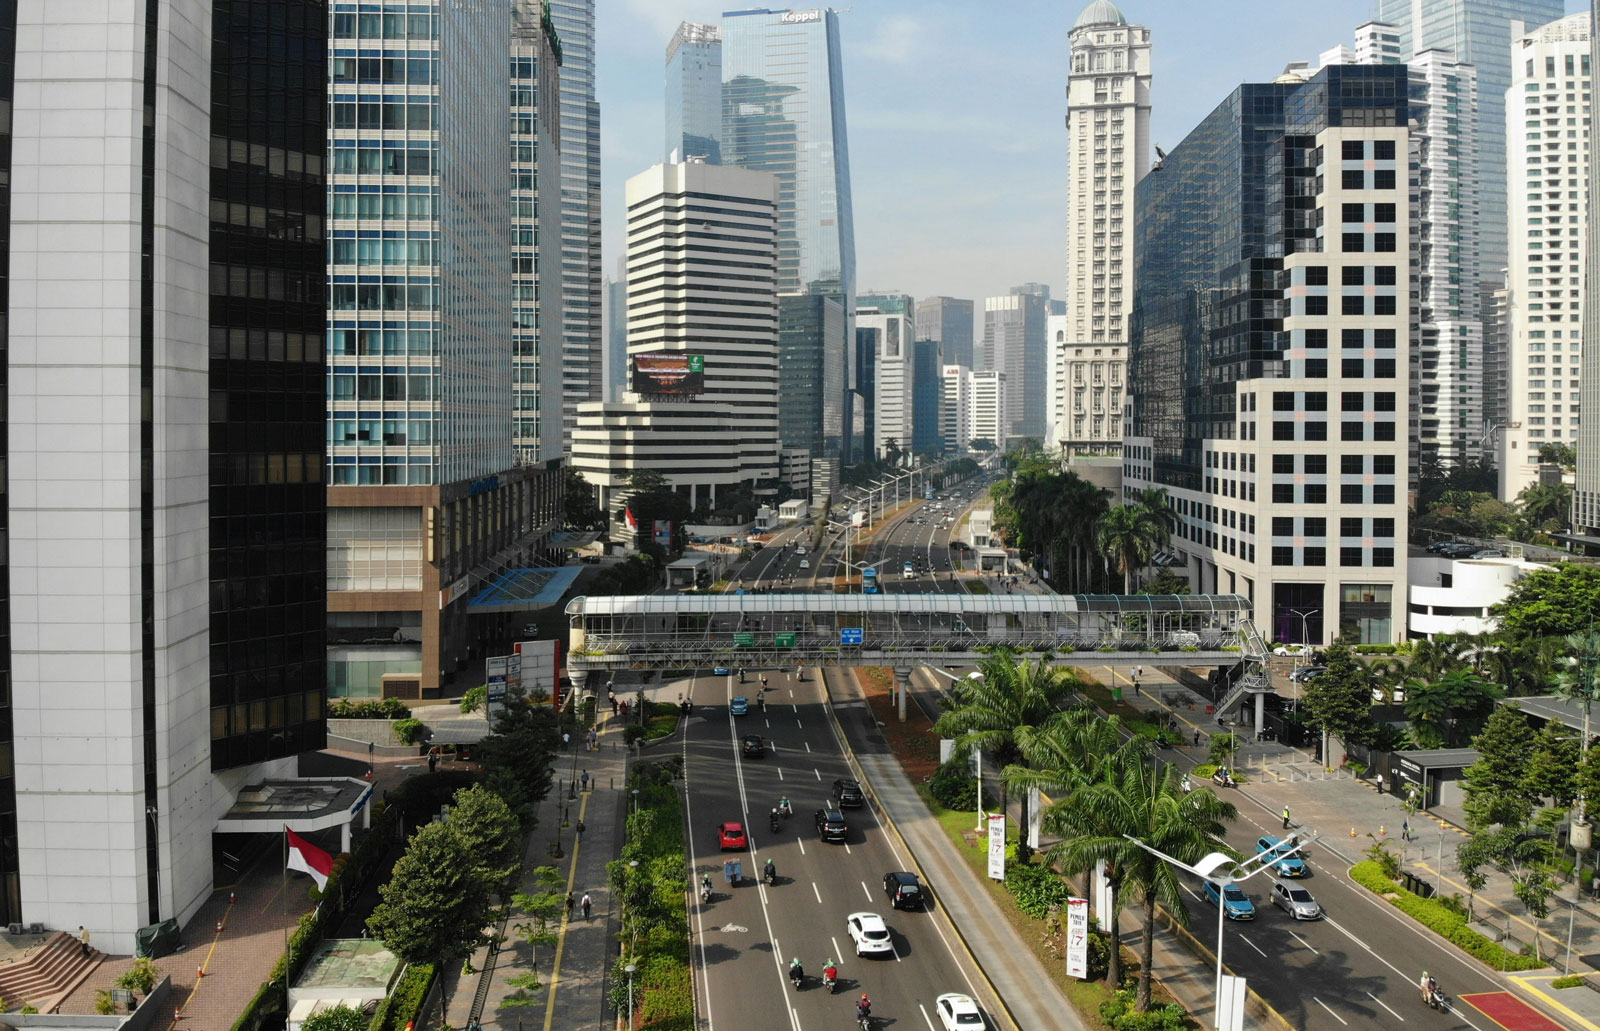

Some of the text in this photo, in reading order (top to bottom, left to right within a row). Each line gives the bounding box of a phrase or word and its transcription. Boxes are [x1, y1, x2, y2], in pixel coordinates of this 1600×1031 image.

[781, 10, 819, 22] Keppel
[992, 844, 1001, 853] 17
[1071, 935, 1083, 946] 17
